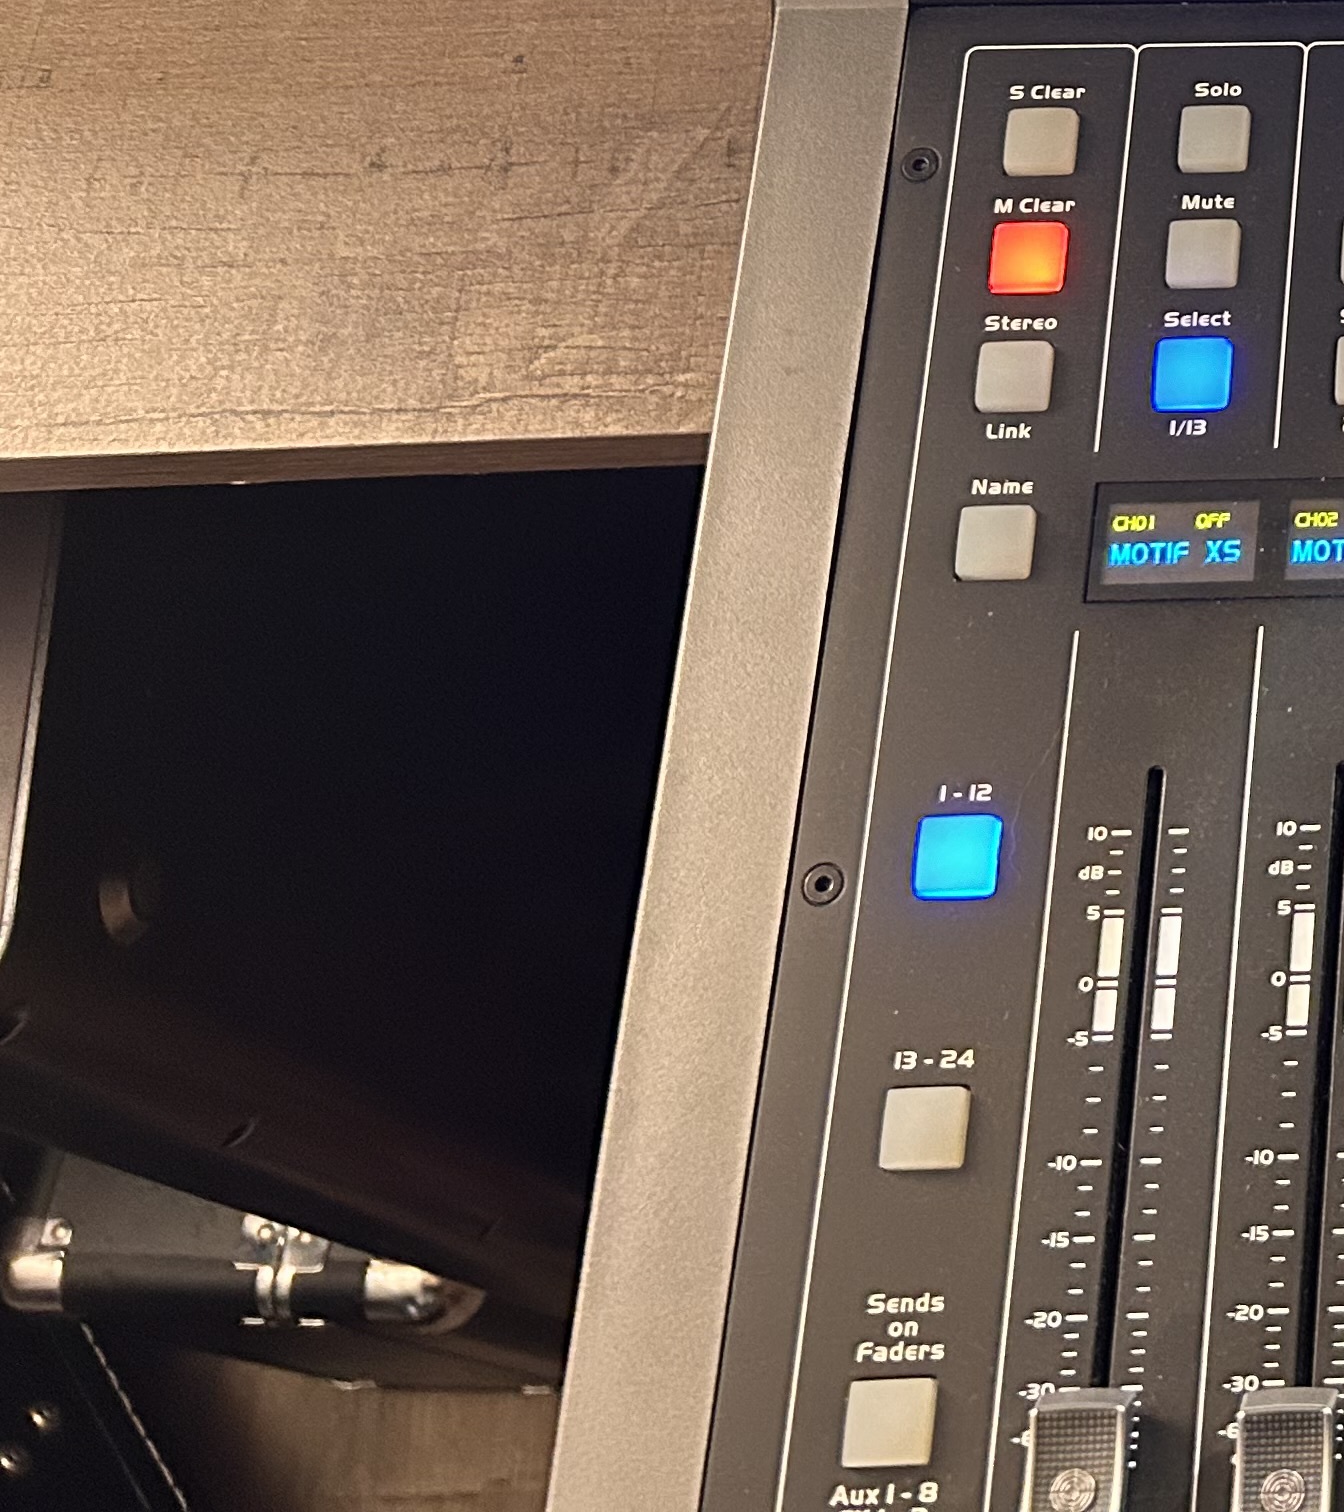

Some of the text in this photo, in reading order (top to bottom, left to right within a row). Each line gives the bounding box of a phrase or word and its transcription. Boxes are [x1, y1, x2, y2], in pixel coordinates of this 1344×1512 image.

[1010, 85, 1085, 99] S Clear
[1195, 83, 1241, 97] Solo
[994, 198, 1075, 213] M Clear
[1182, 195, 1234, 209] Mute
[985, 316, 1057, 331] Stereo
[1164, 311, 1231, 327] Select
[986, 423, 1031, 439] Link
[1170, 420, 1206, 436] 1/13
[972, 479, 1033, 494] Name
[1113, 513, 1230, 532] CH01 OFF
[1109, 540, 1240, 566] MOTIF XS
[1078, 866, 1104, 880] dB
[867, 1293, 944, 1314] Sends
[888, 1321, 918, 1337] on
[856, 1341, 944, 1362] Faders
